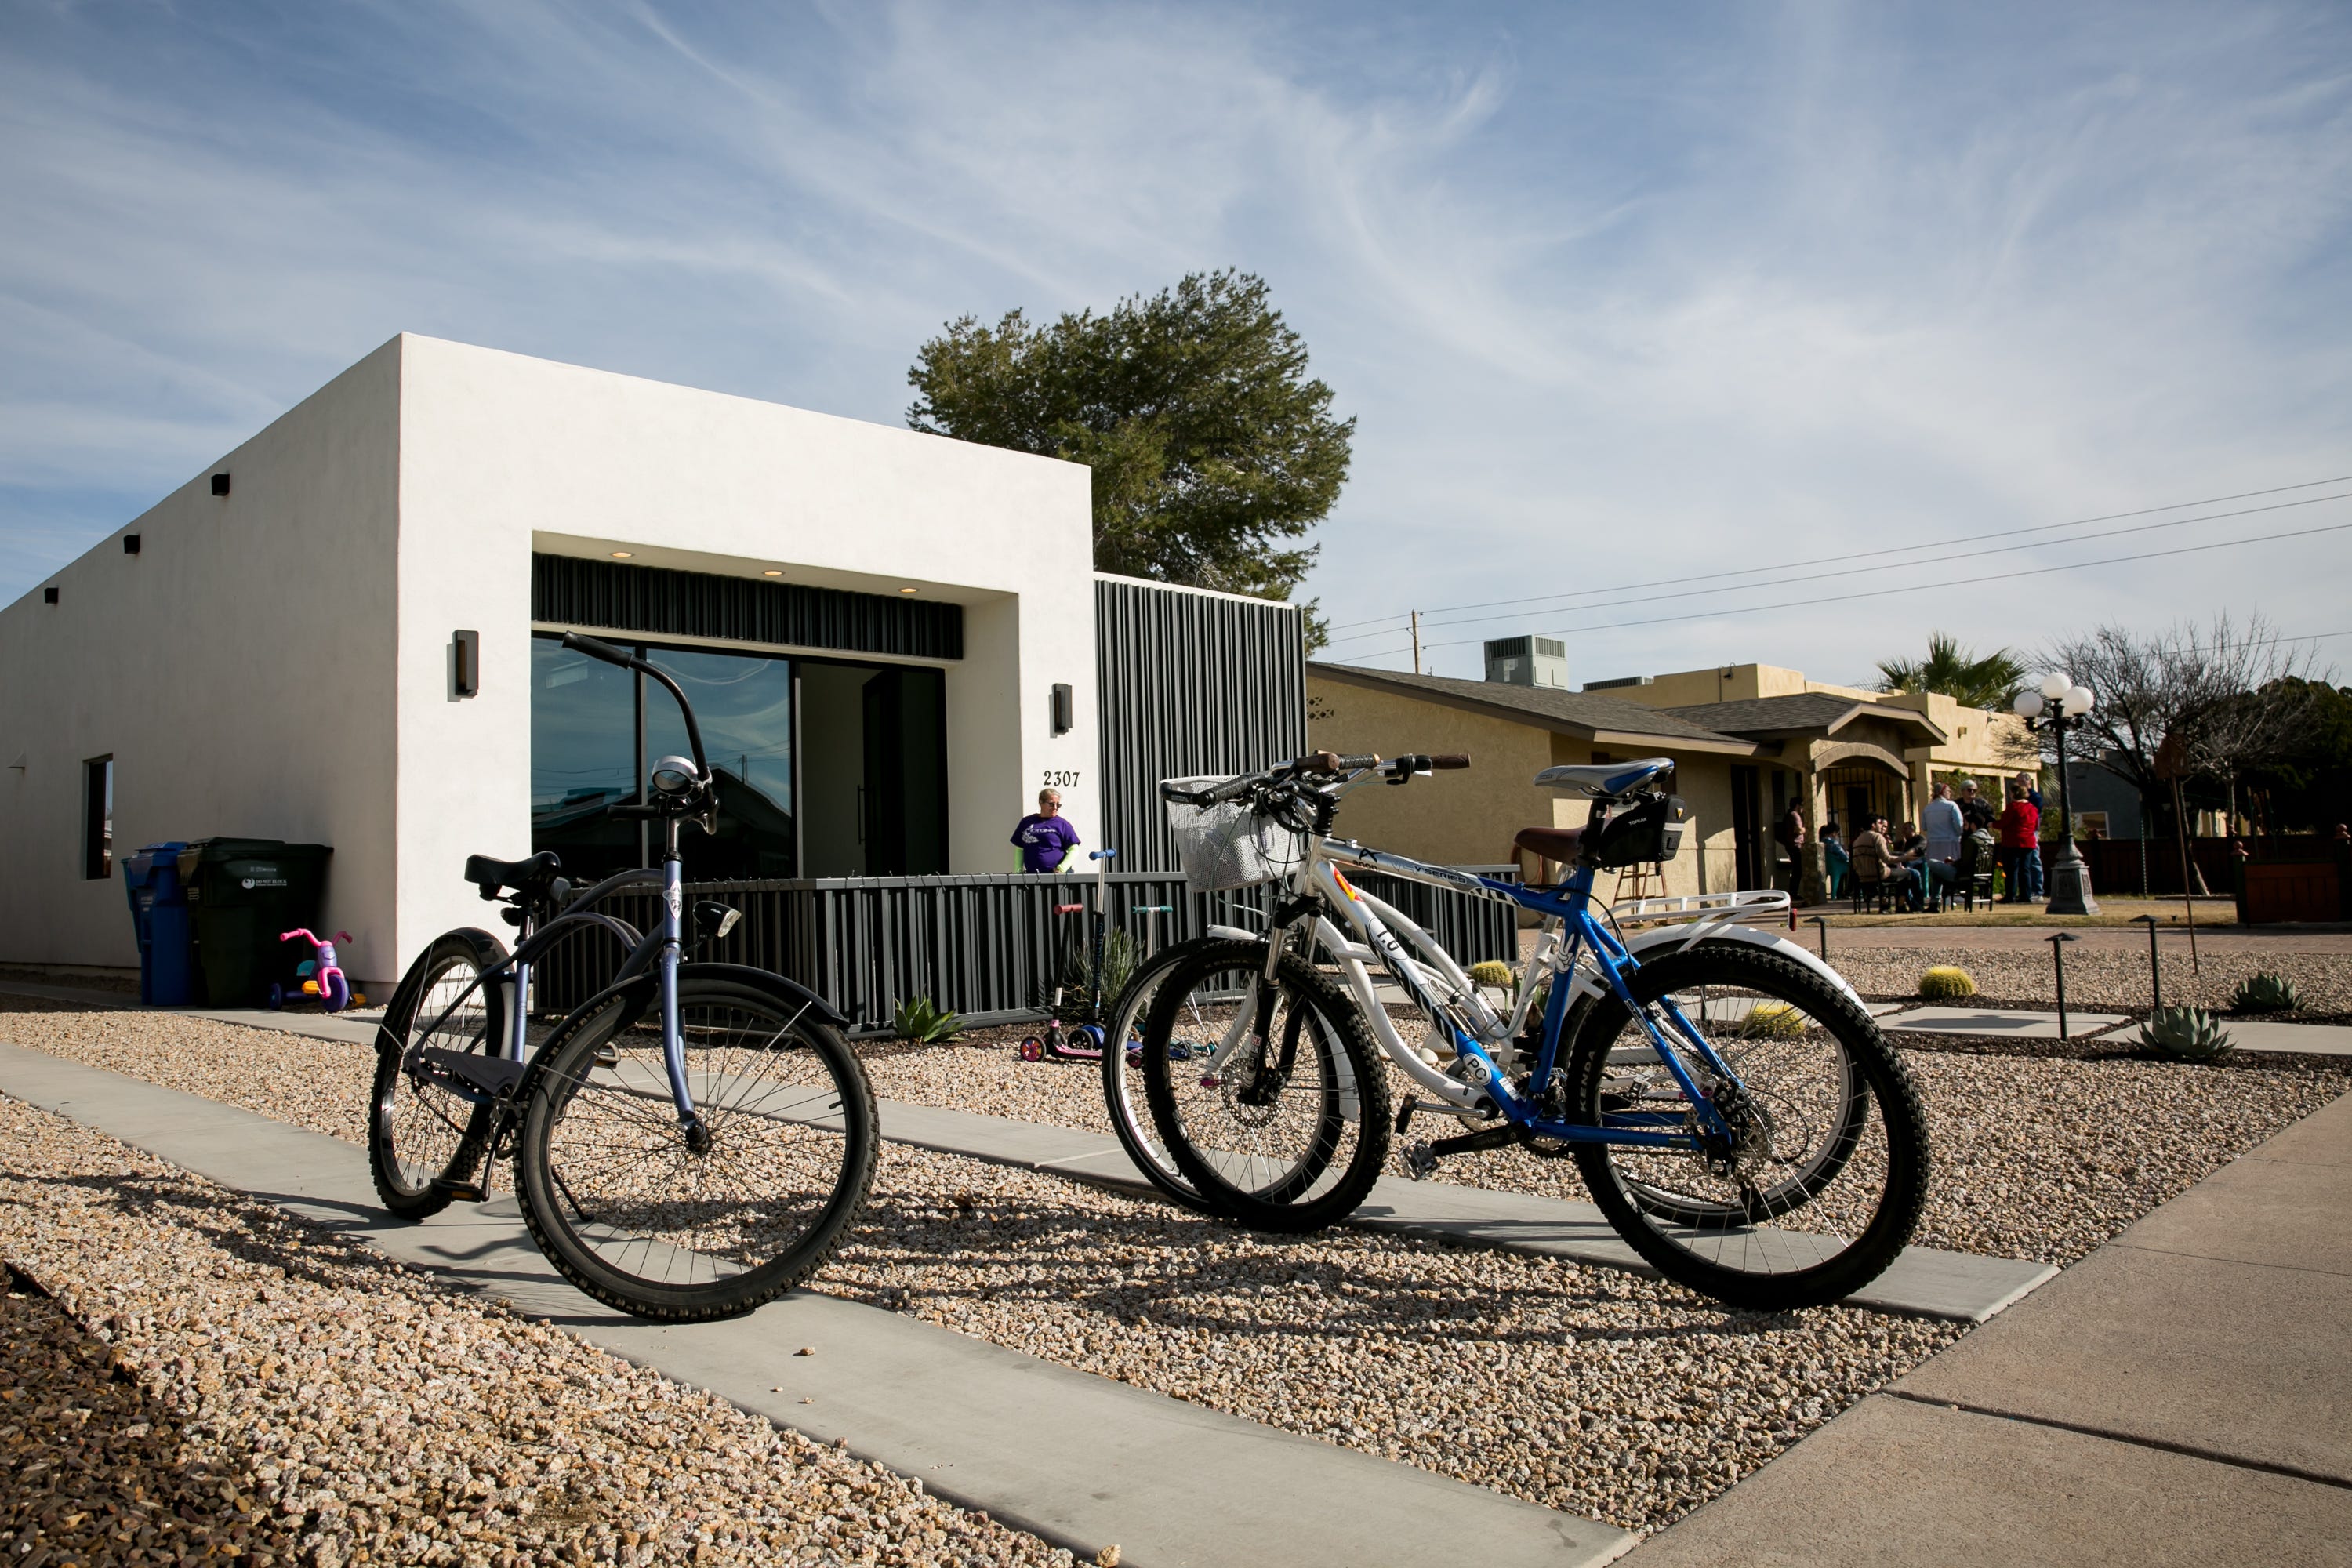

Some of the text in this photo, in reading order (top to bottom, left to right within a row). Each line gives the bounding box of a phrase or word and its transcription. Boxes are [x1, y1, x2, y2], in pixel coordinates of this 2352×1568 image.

[1044, 770, 1080, 787] 2307
[1628, 817, 1647, 826] TOPEAK
[1352, 859, 1377, 871] anon
[1467, 1058, 1487, 1080] PC
[1579, 1051, 1596, 1112] KENDA
